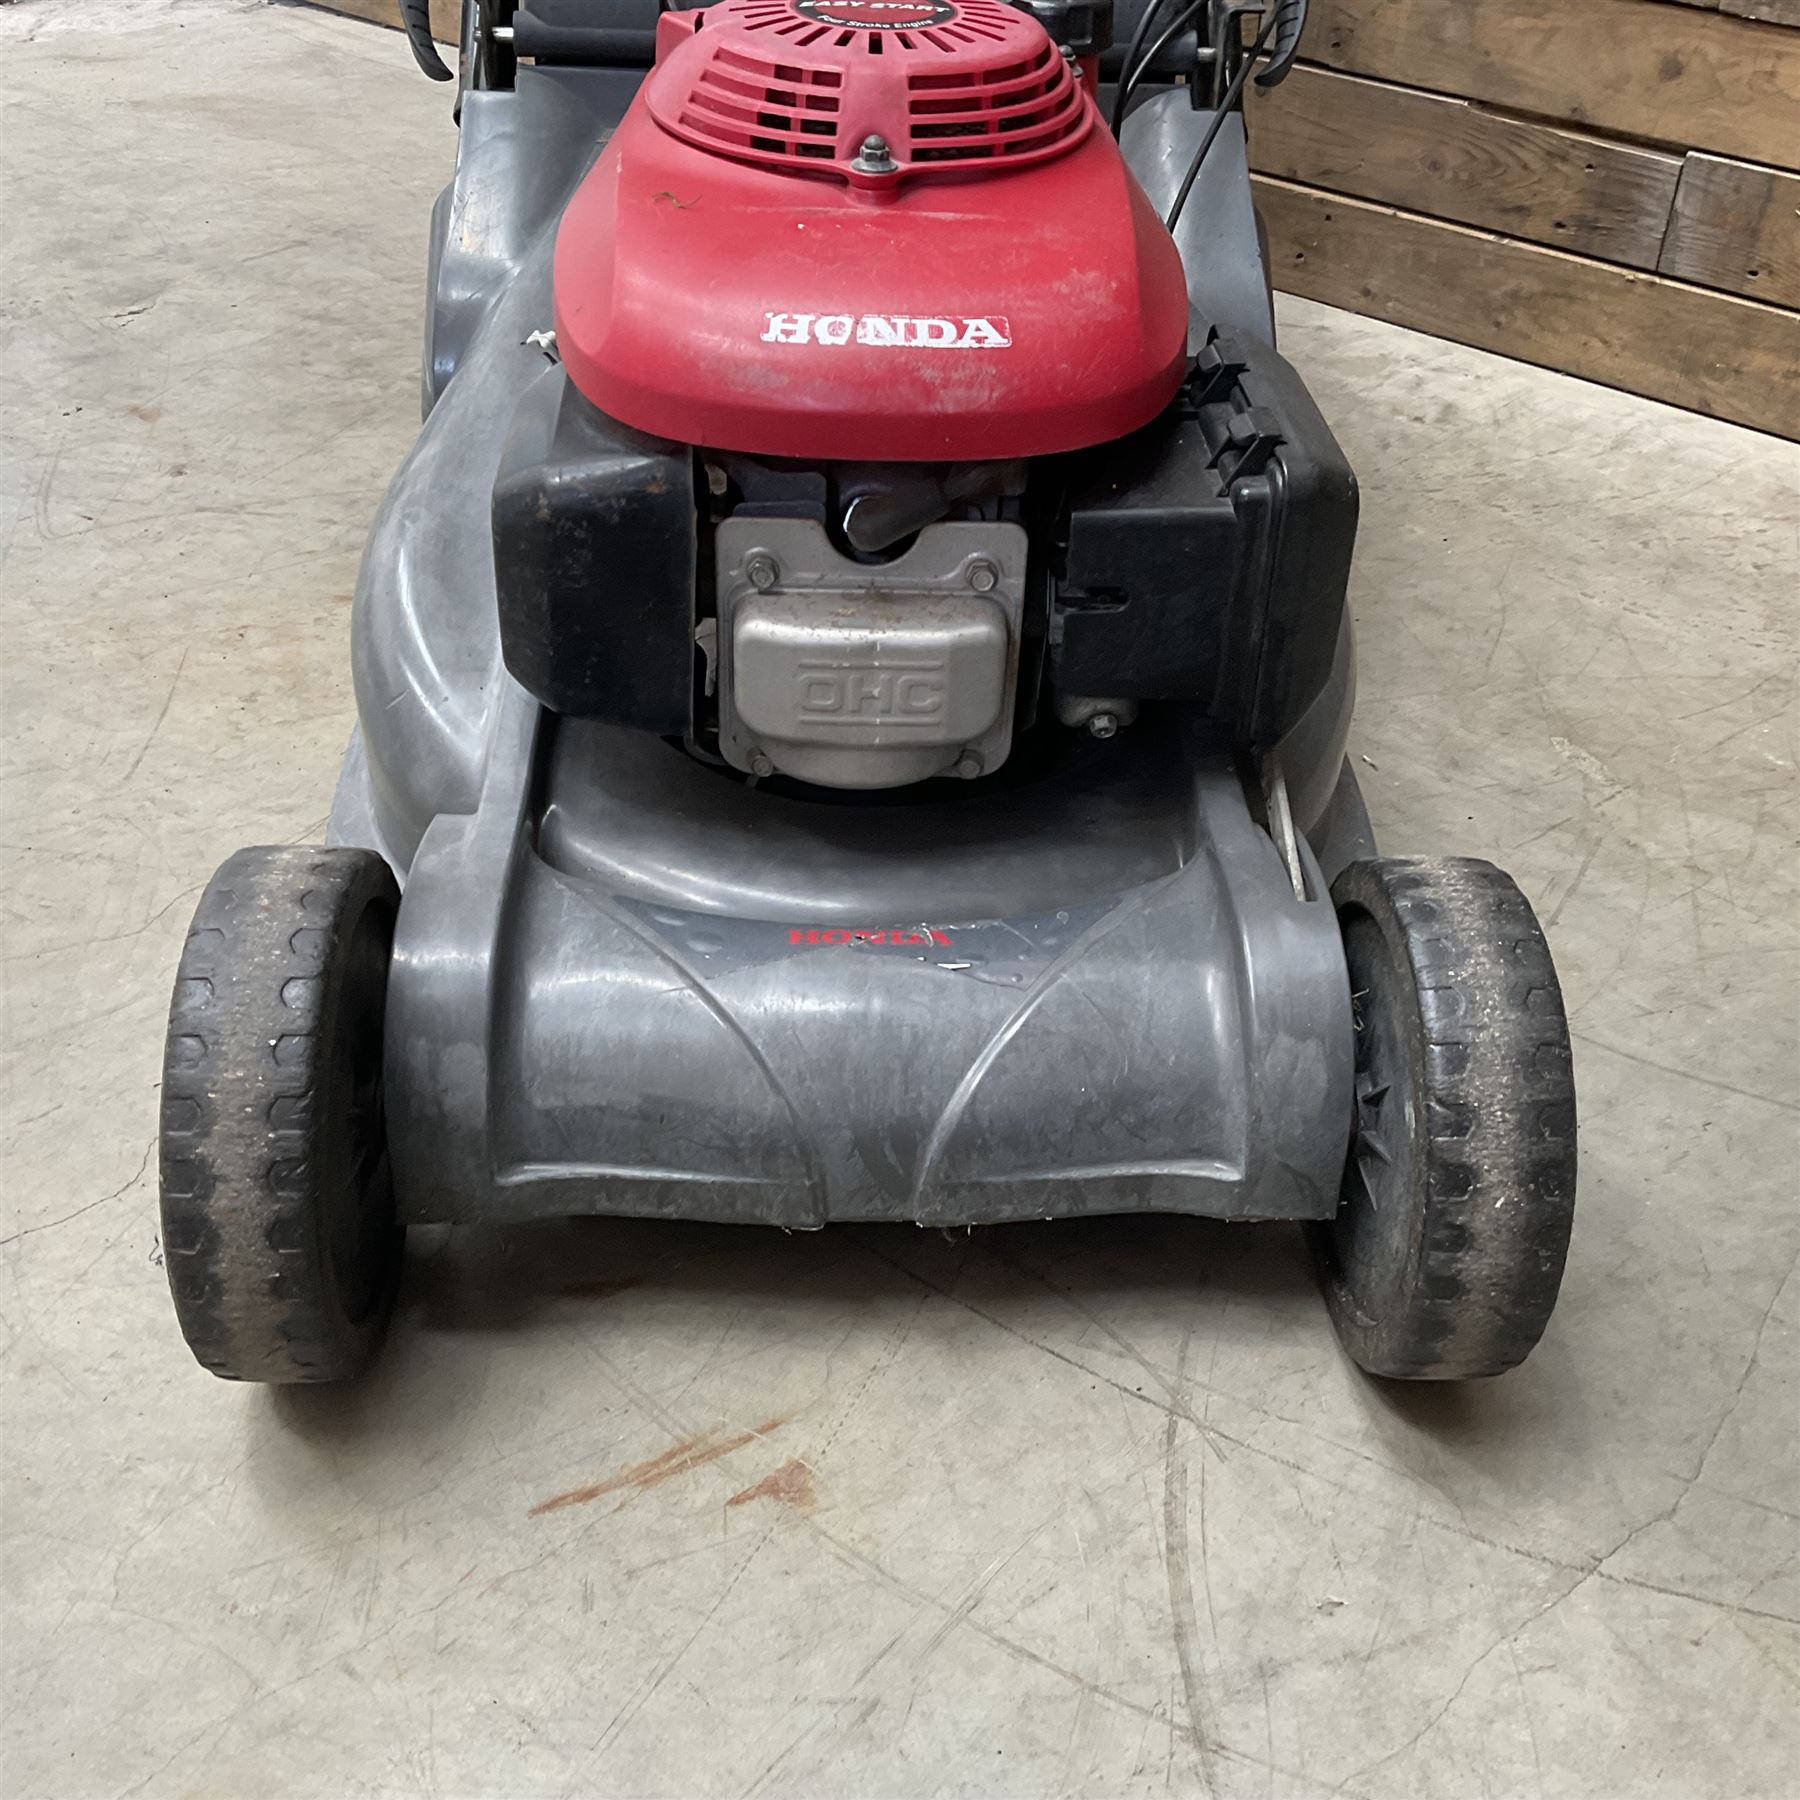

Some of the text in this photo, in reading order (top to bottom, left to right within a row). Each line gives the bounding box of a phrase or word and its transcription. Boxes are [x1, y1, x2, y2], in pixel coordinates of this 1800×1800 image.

[869, 2, 950, 12] START
[817, 14, 934, 29] Four Stroke Engine
[760, 312, 1010, 347] HONDA
[800, 673, 943, 713] OHC
